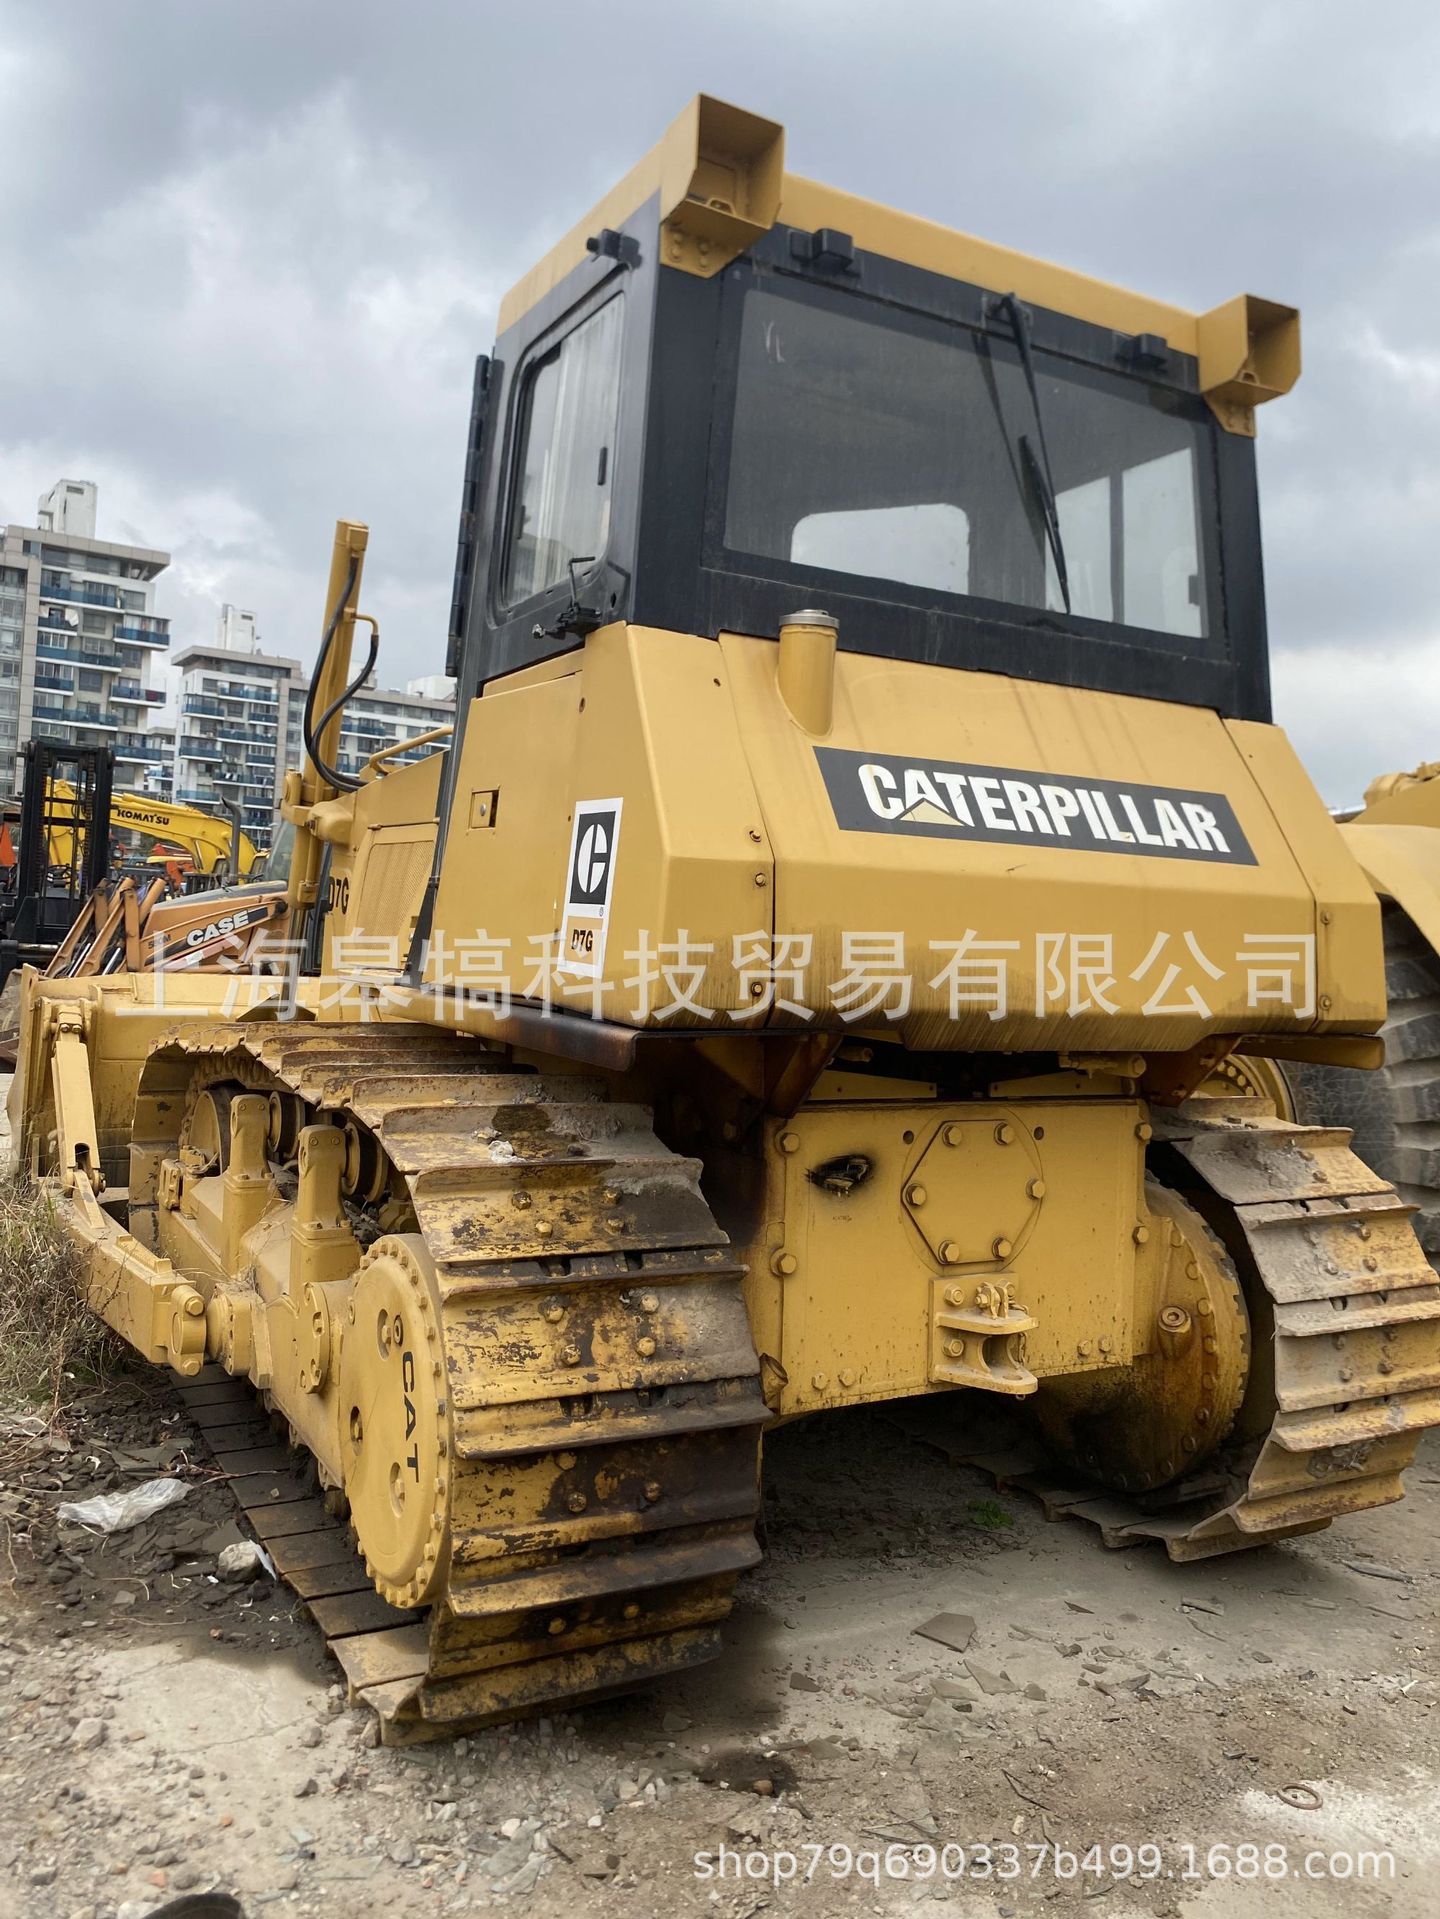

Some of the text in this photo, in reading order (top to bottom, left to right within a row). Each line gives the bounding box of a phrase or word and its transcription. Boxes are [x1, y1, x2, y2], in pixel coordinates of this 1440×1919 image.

[117, 809, 170, 825] KOMATSU
[858, 764, 1231, 853] CATERPILLAR
[328, 876, 350, 915] D7G
[187, 910, 249, 947] CASE
[571, 929, 593, 952] D7G
[402, 1351, 419, 1483] CAT
